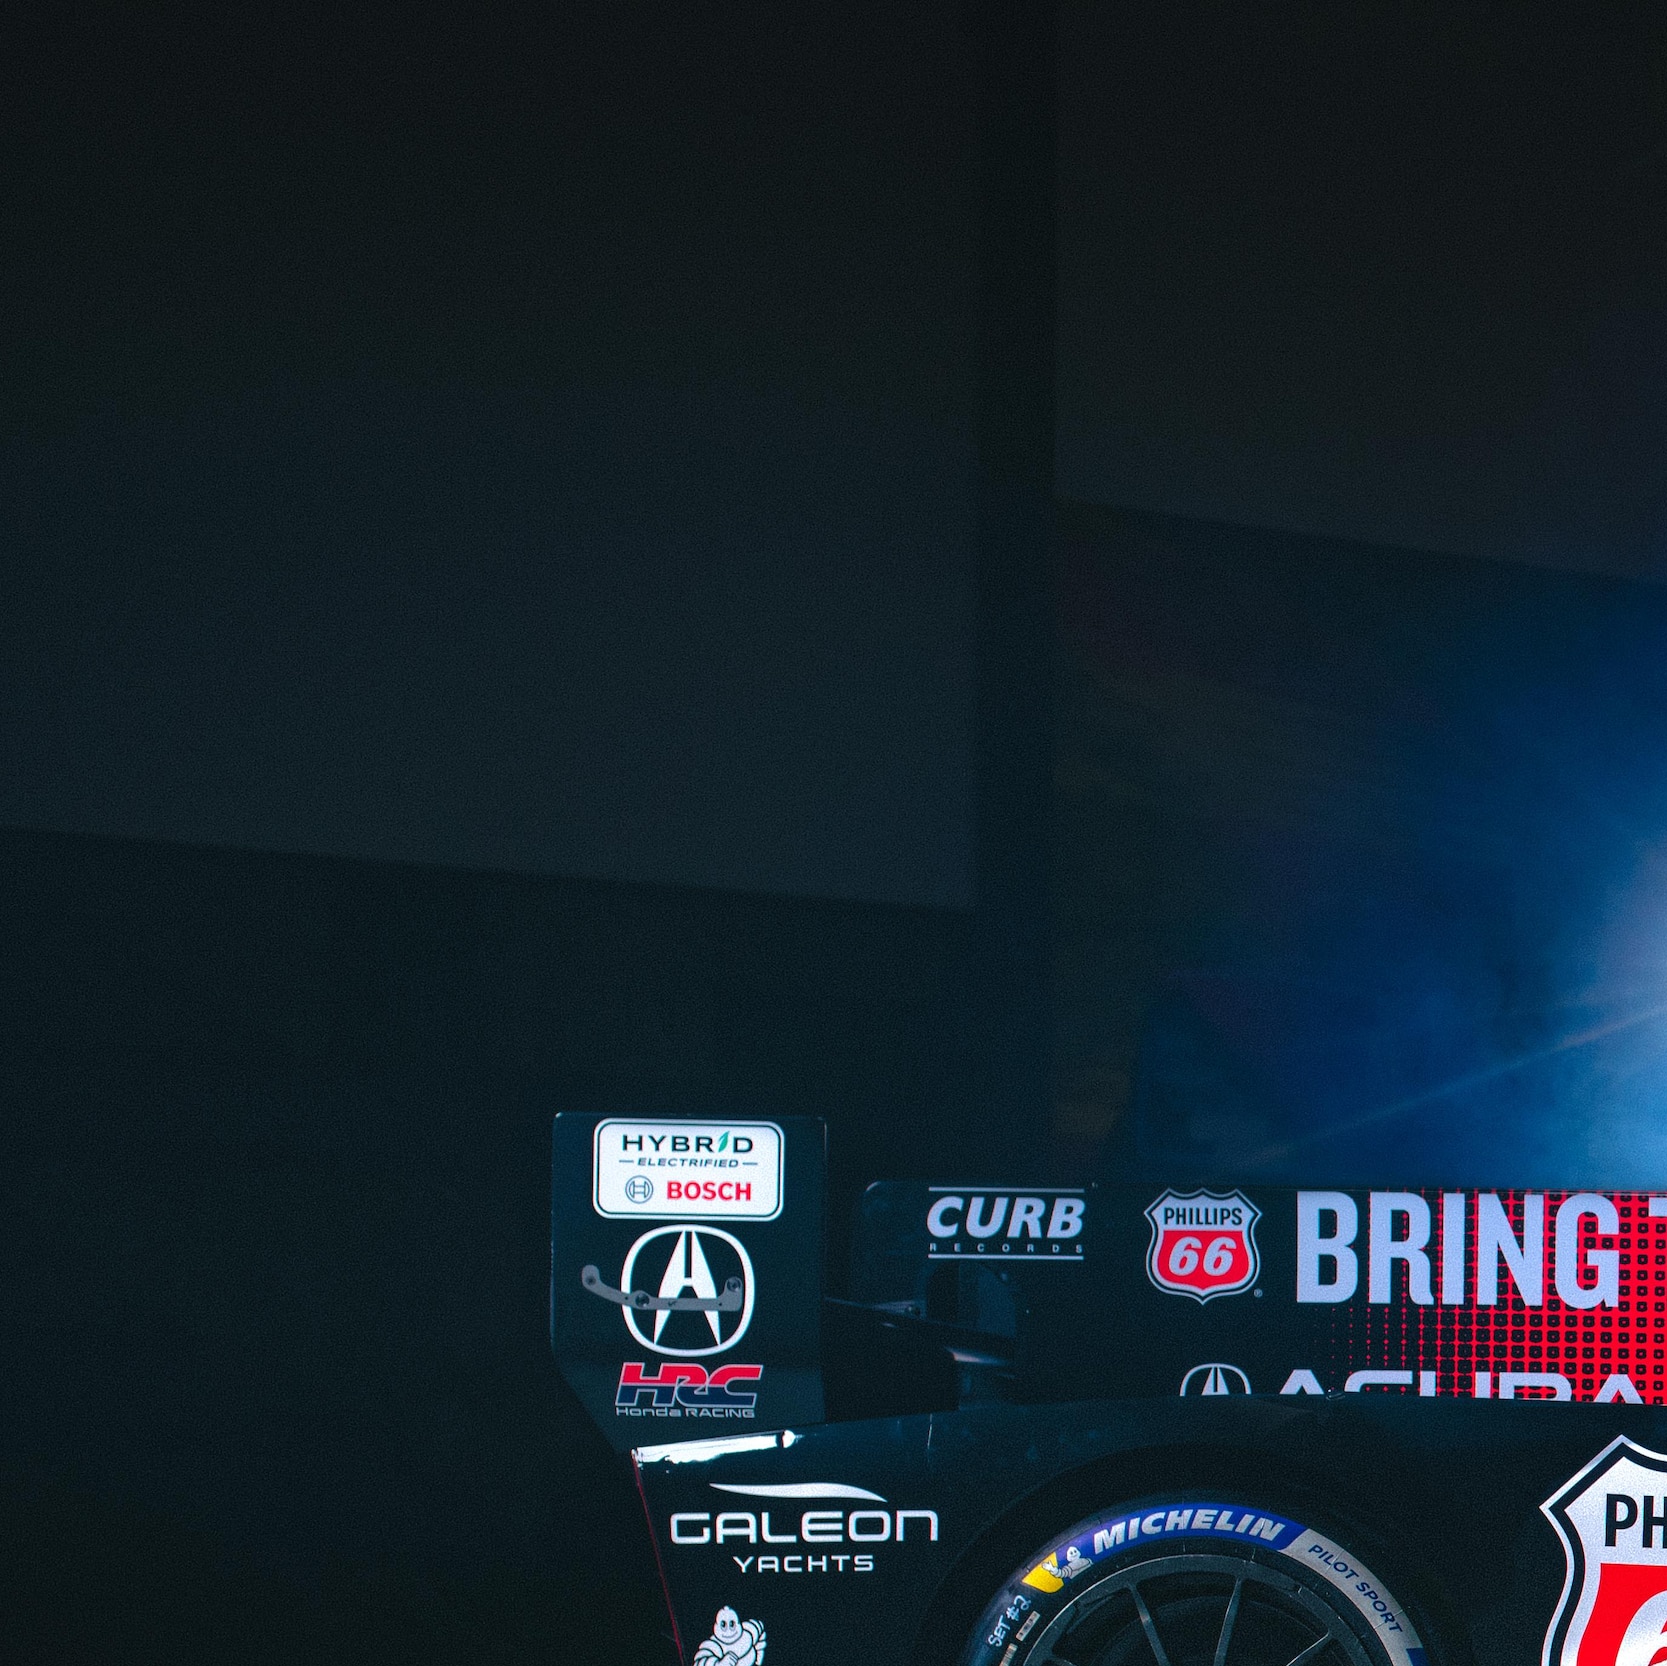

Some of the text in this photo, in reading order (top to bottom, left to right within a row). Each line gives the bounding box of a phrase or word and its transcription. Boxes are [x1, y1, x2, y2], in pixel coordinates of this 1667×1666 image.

[623, 1130, 754, 1153] HYBRID
[637, 1157, 739, 1168] ELECTRIFIED
[666, 1181, 752, 1202] BOSCH
[926, 1195, 1086, 1240] CURB
[1163, 1206, 1243, 1227] PHILLIPS
[929, 1242, 1084, 1254] RECORDS
[1167, 1235, 1236, 1277] 66
[1295, 1190, 1619, 1311] BRING
[615, 1362, 764, 1408] HRC
[616, 1406, 756, 1418] Honda RACING
[669, 1509, 940, 1545] GALEON
[732, 1554, 875, 1573] YACHTS
[1093, 1508, 1403, 1634] MICHELIN PILOT SPORT
[987, 1615, 1012, 1647] SET
